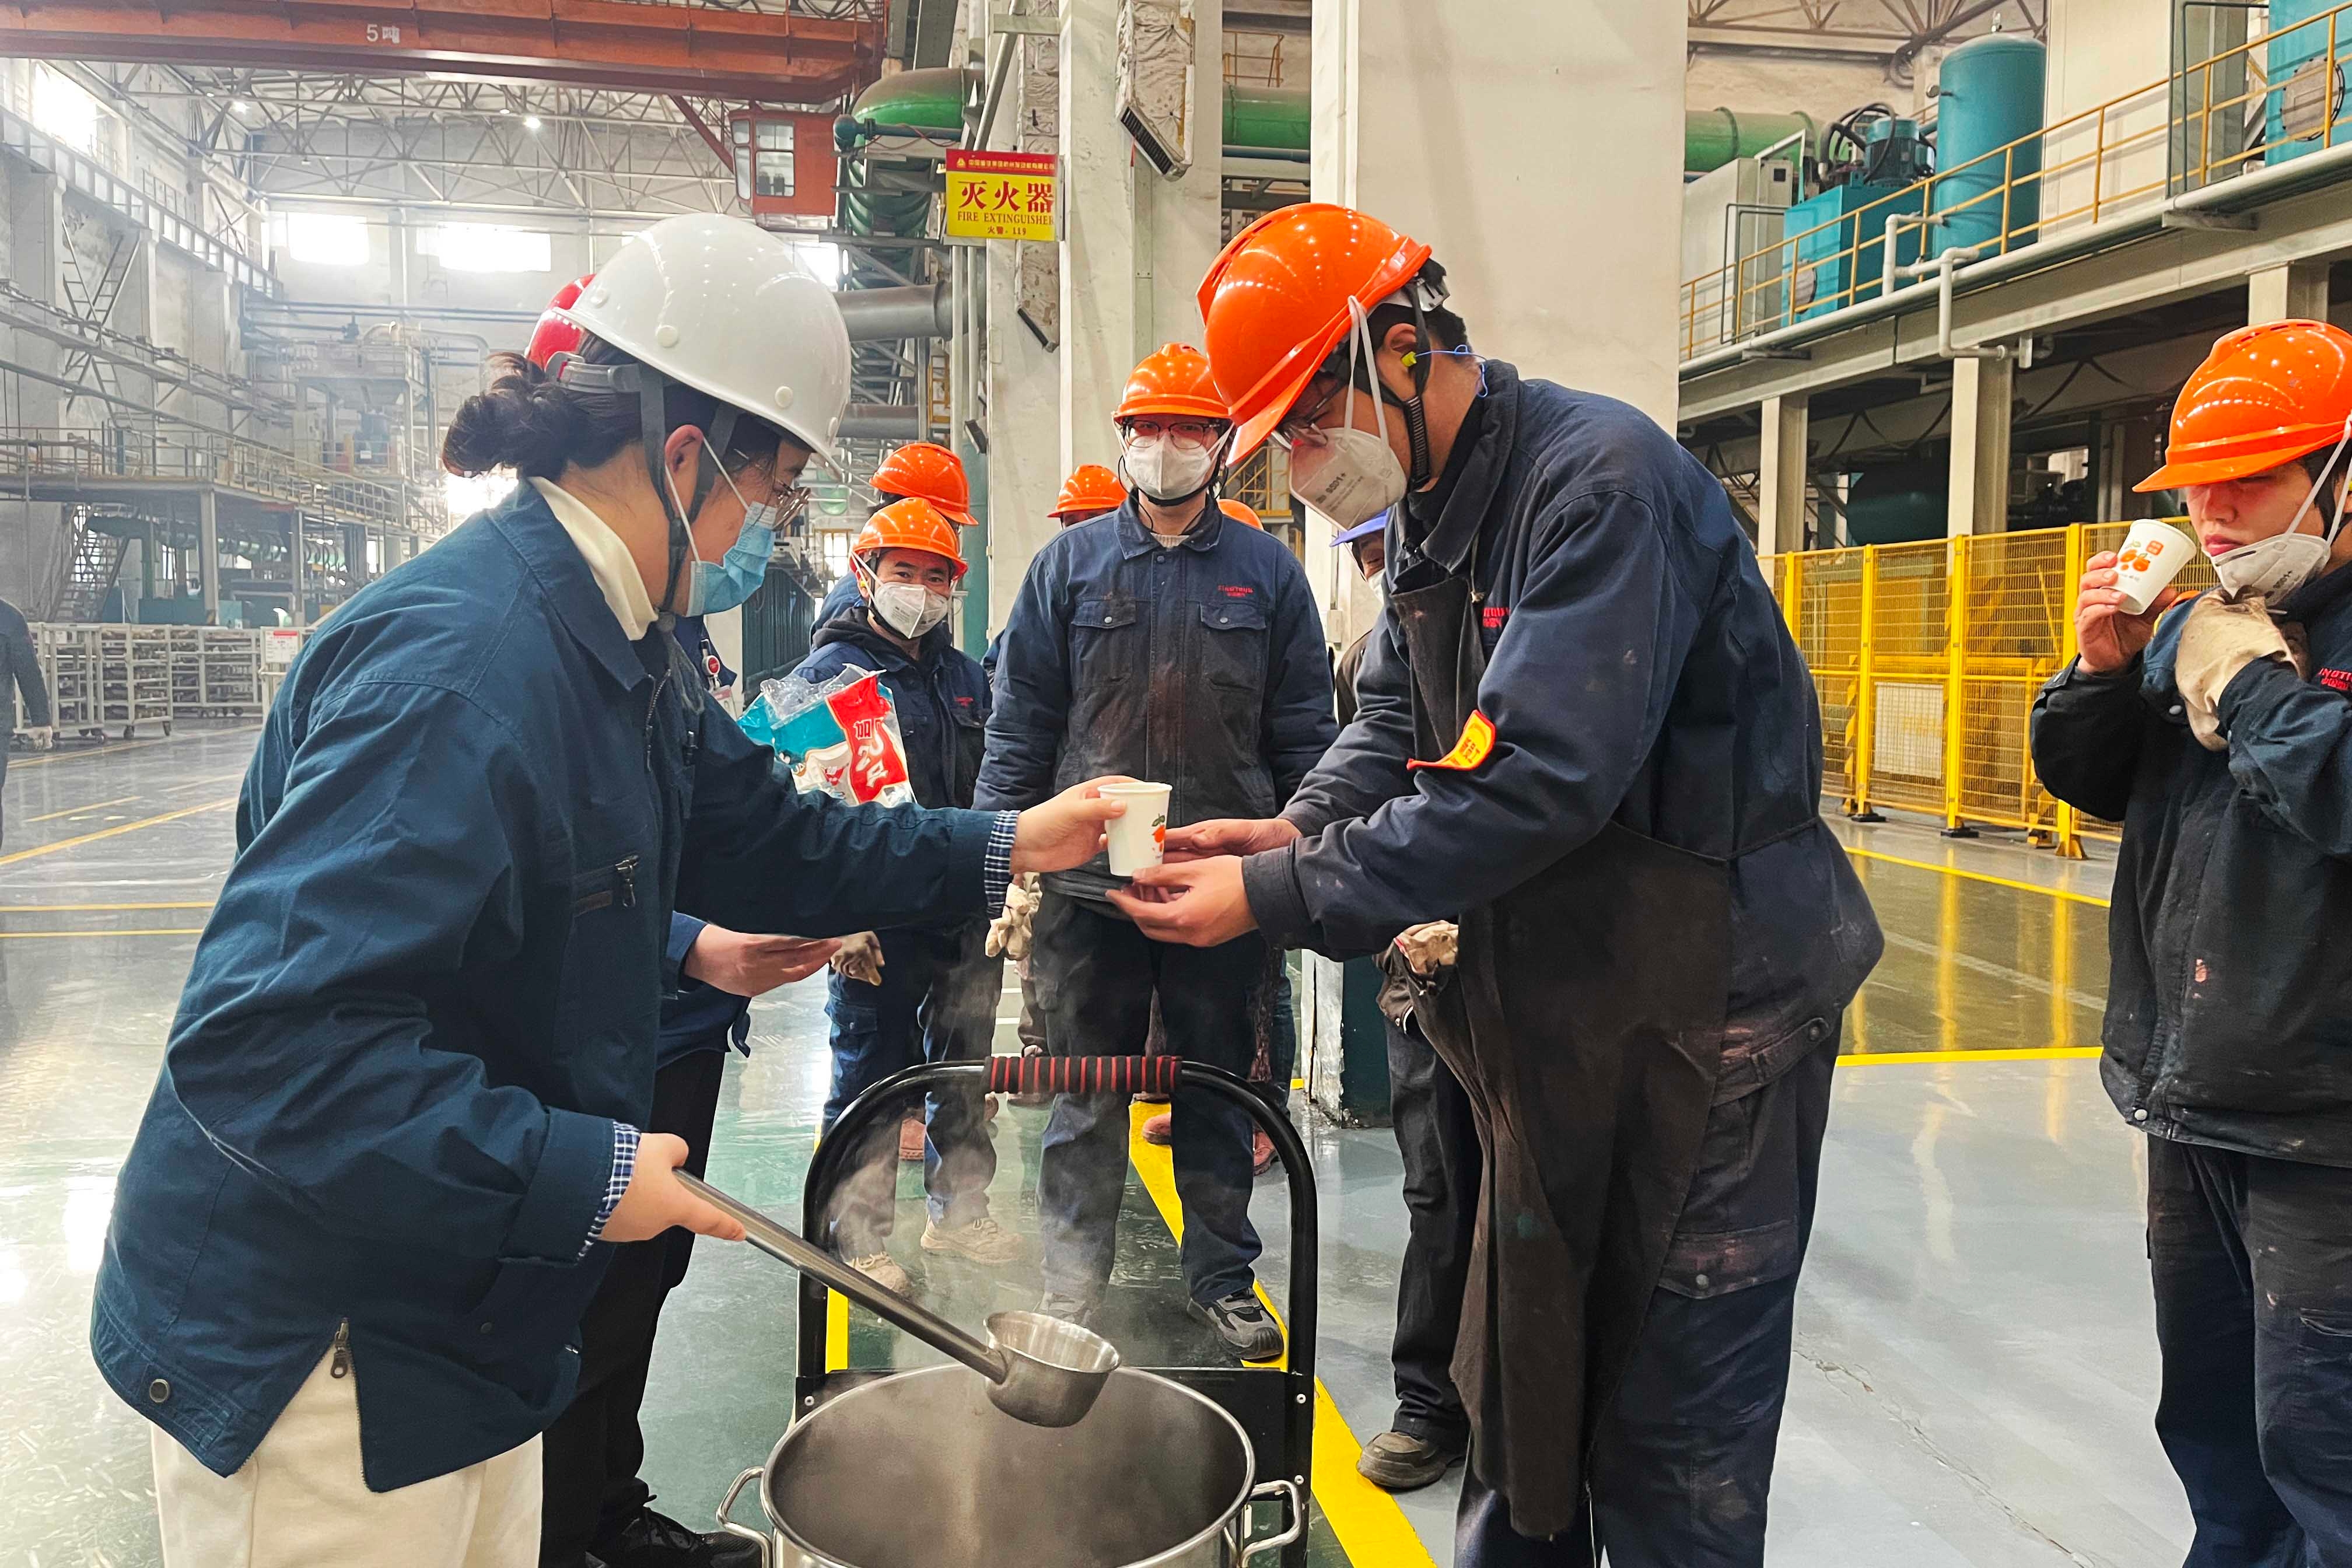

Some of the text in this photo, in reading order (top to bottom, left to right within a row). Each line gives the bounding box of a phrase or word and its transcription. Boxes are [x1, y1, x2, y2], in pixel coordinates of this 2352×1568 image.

[958, 180, 1055, 213] 灭火器
[957, 211, 1054, 225] FIRE EXTINGUISHER
[1013, 227, 1027, 235] 119
